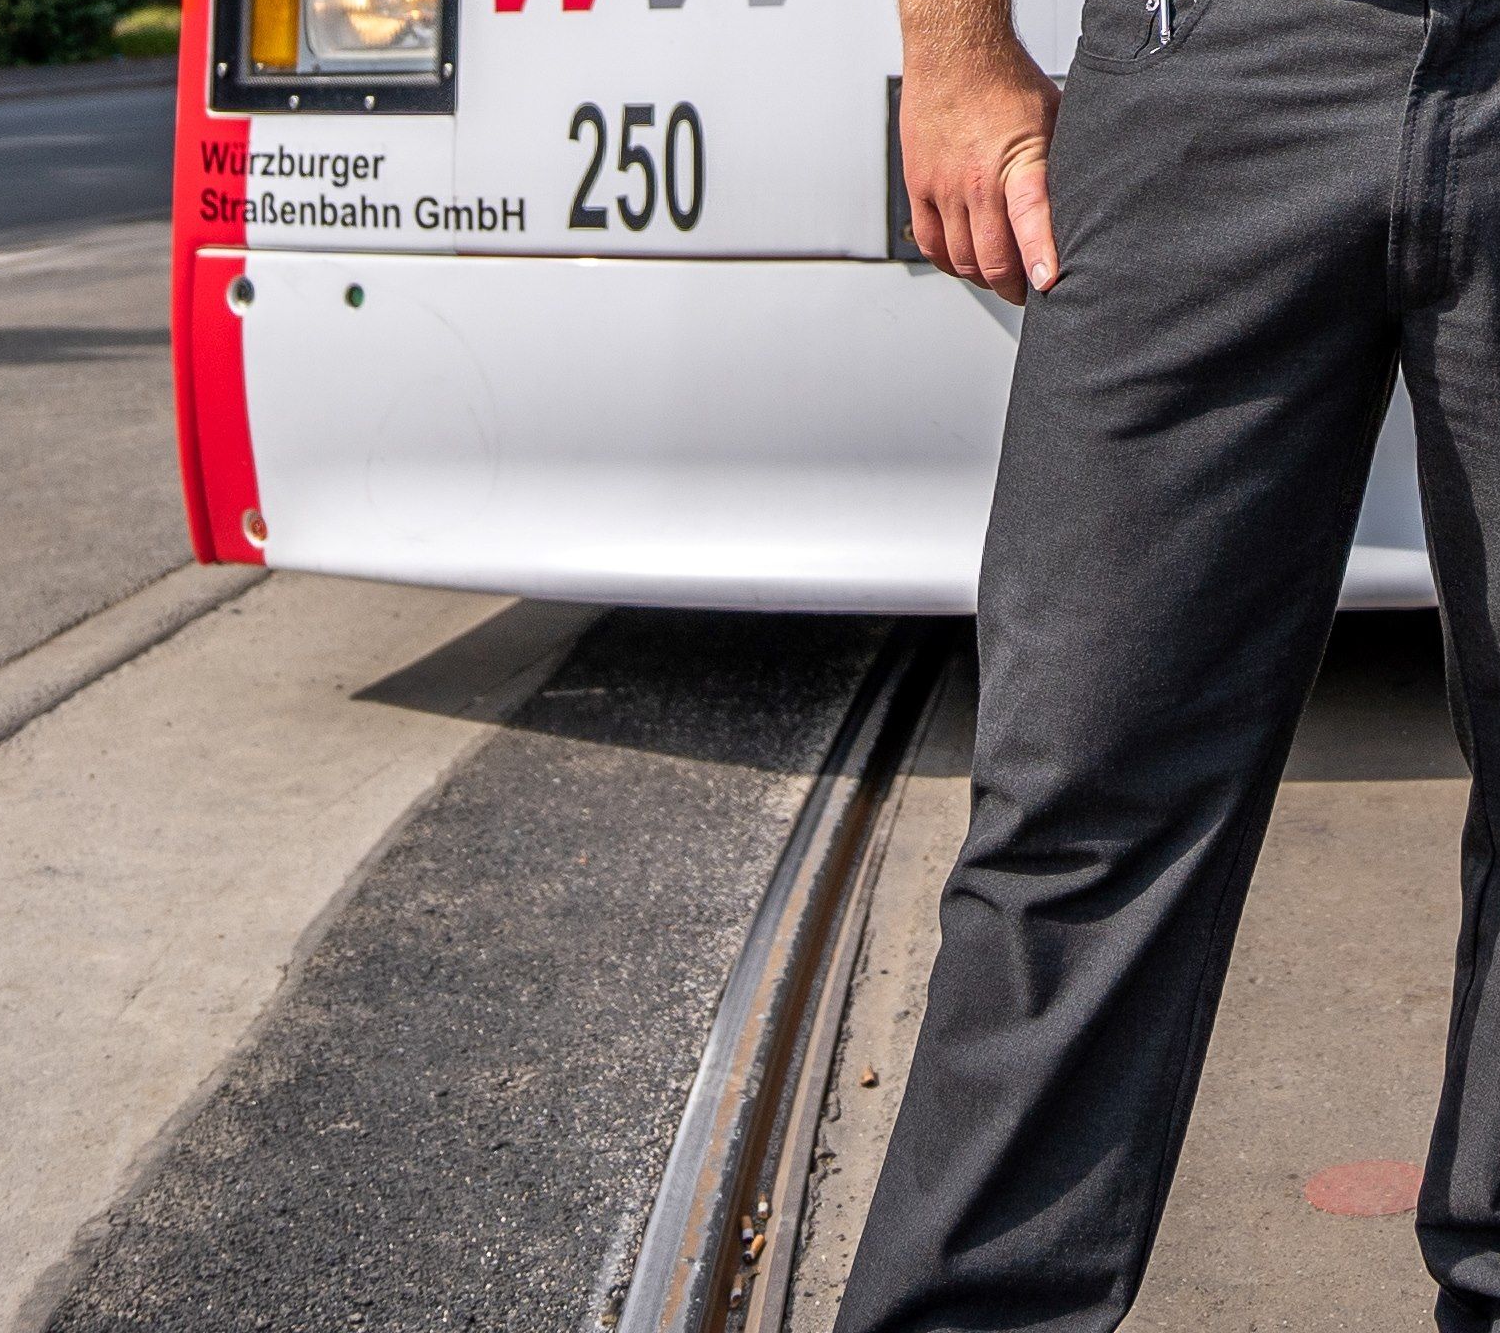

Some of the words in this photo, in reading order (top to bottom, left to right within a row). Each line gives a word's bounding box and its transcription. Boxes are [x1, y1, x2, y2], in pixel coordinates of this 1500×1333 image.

[200, 140, 386, 188] Würzburger
[568, 100, 706, 231] 250
[200, 187, 401, 229] Straßenbahn
[414, 195, 527, 233] GmbH
